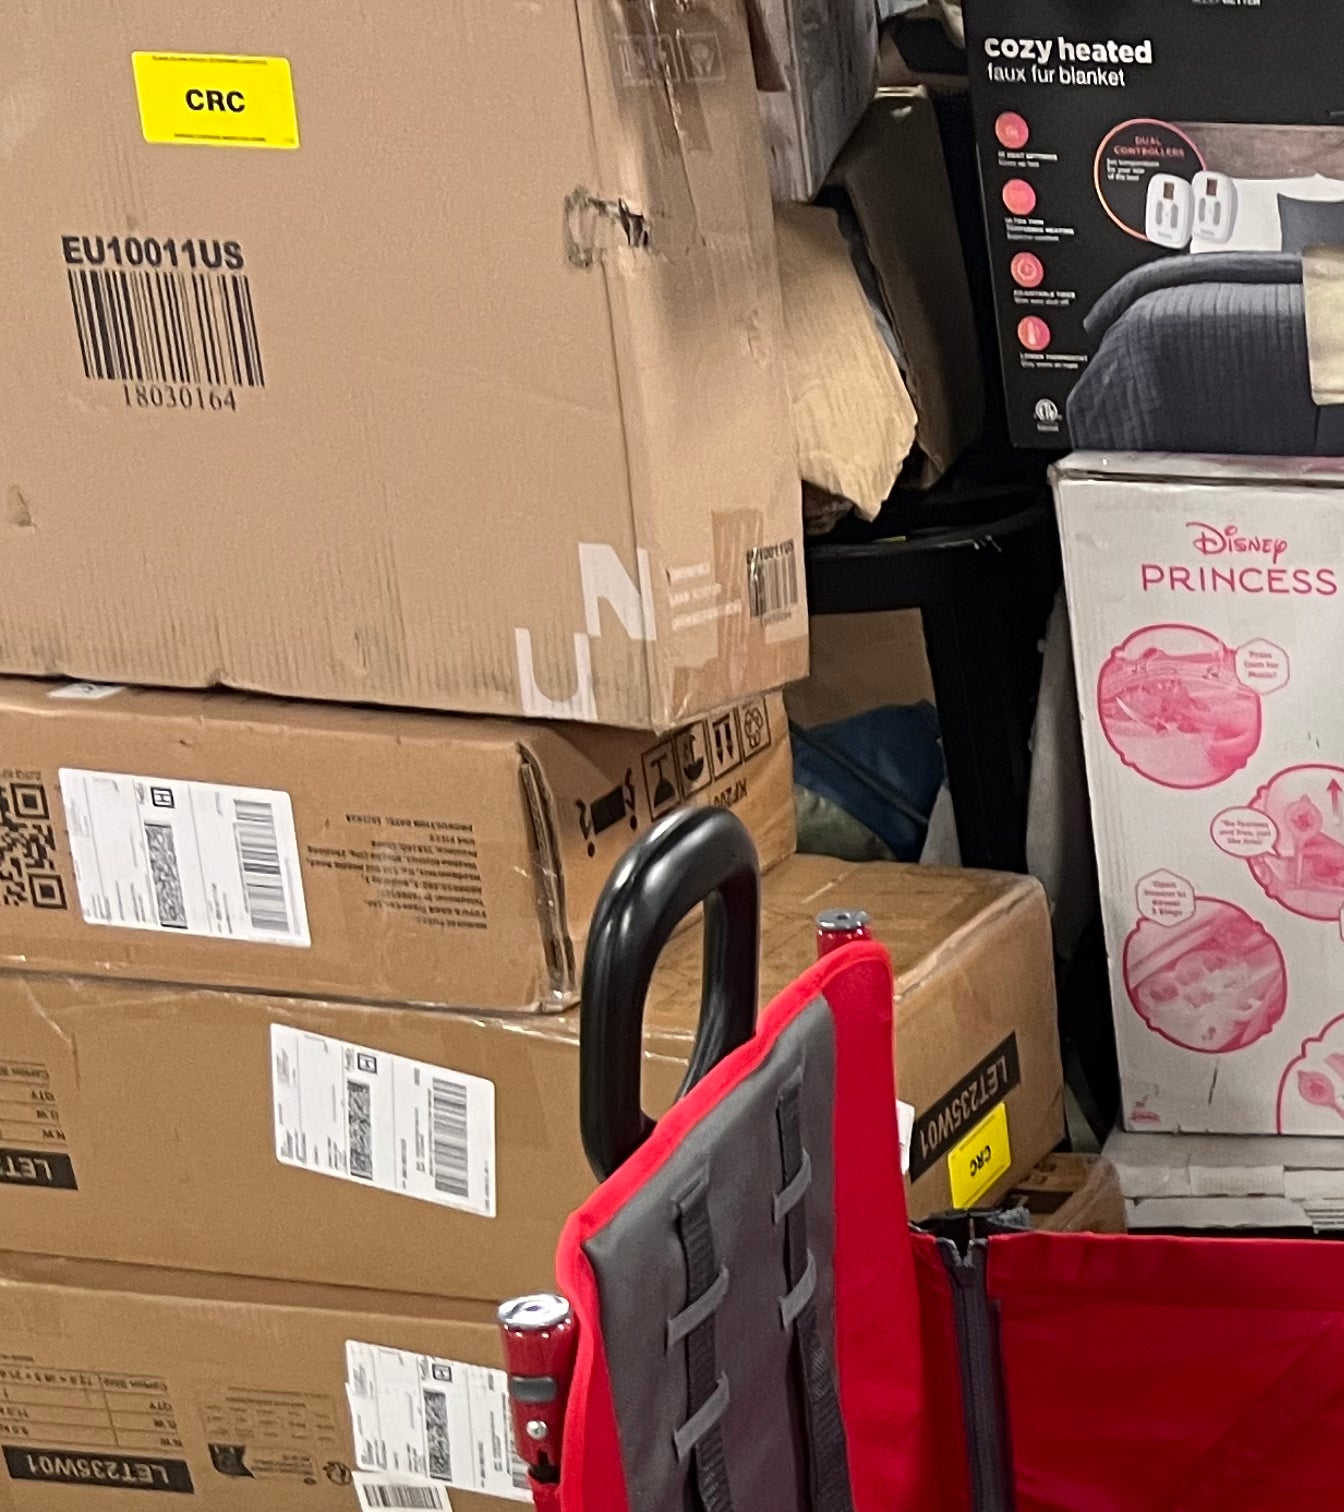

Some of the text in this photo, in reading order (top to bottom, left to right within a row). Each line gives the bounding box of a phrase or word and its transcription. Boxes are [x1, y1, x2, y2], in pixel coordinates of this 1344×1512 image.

[984, 36, 1153, 65] cozy heated
[987, 64, 1126, 87] faux fur blanket
[185, 88, 246, 114] CRC
[1113, 145, 1185, 158] CONTROLLERS
[1135, 135, 1162, 147] DUAL
[61, 236, 245, 270] EU10011US
[123, 384, 238, 411] 18030164
[1185, 521, 1288, 563] Disney
[1141, 564, 1338, 596] PRINCESS
[920, 1055, 1008, 1159] LET235W01
[969, 1144, 991, 1176] CRC
[26, 1454, 169, 1485] LET235W01
